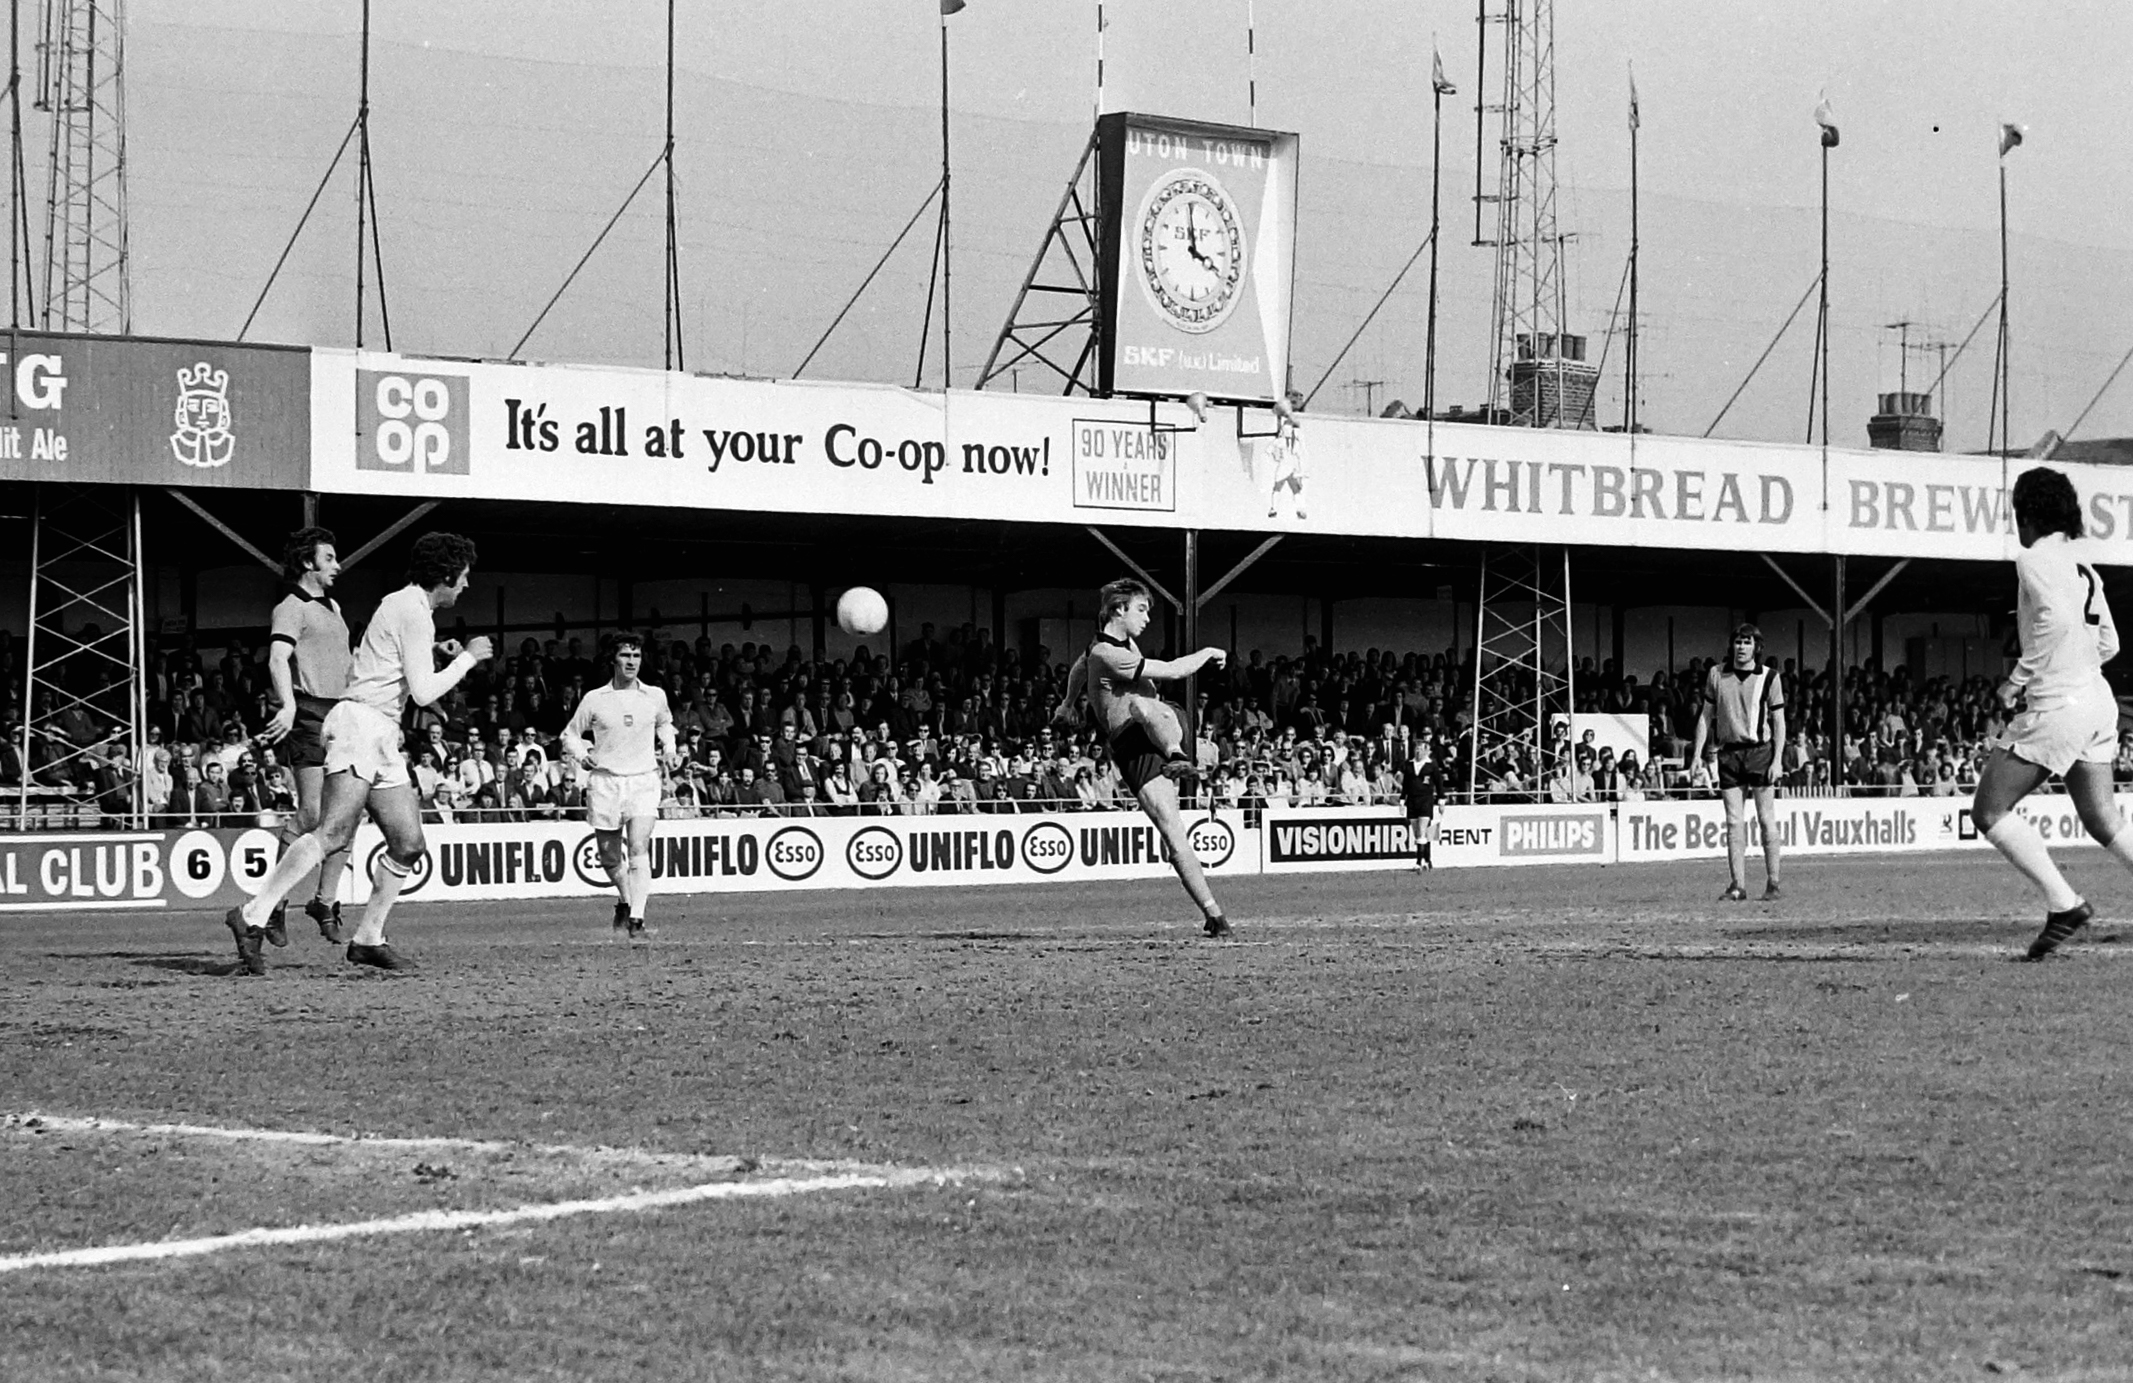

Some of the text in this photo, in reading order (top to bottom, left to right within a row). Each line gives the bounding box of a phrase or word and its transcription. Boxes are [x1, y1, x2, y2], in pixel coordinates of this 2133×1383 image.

[1202, 140, 1263, 170] TOWN
[1123, 345, 1175, 367] SKF
[1208, 352, 1260, 374] Limited
[0, 352, 68, 409] G
[31, 427, 69, 461] Ale
[505, 398, 1050, 484] It's all at your Co-op now!
[1082, 428, 1167, 461] 90 YEARS
[1085, 470, 1162, 503] WINNER
[1420, 455, 1794, 525] WHITBREAD
[2076, 563, 2100, 625] 2
[1439, 828, 1492, 845] RENT
[1507, 820, 1596, 849] PHILIPS
[1629, 814, 1678, 850] The
[1802, 811, 1917, 847] Vauxhalls
[40, 842, 164, 898] CLUB
[187, 848, 211, 880] 6
[244, 848, 268, 879] 5
[440, 839, 565, 887] UNIFLO
[650, 833, 759, 879] UNIFLO
[909, 829, 1015, 872] UNIFLO
